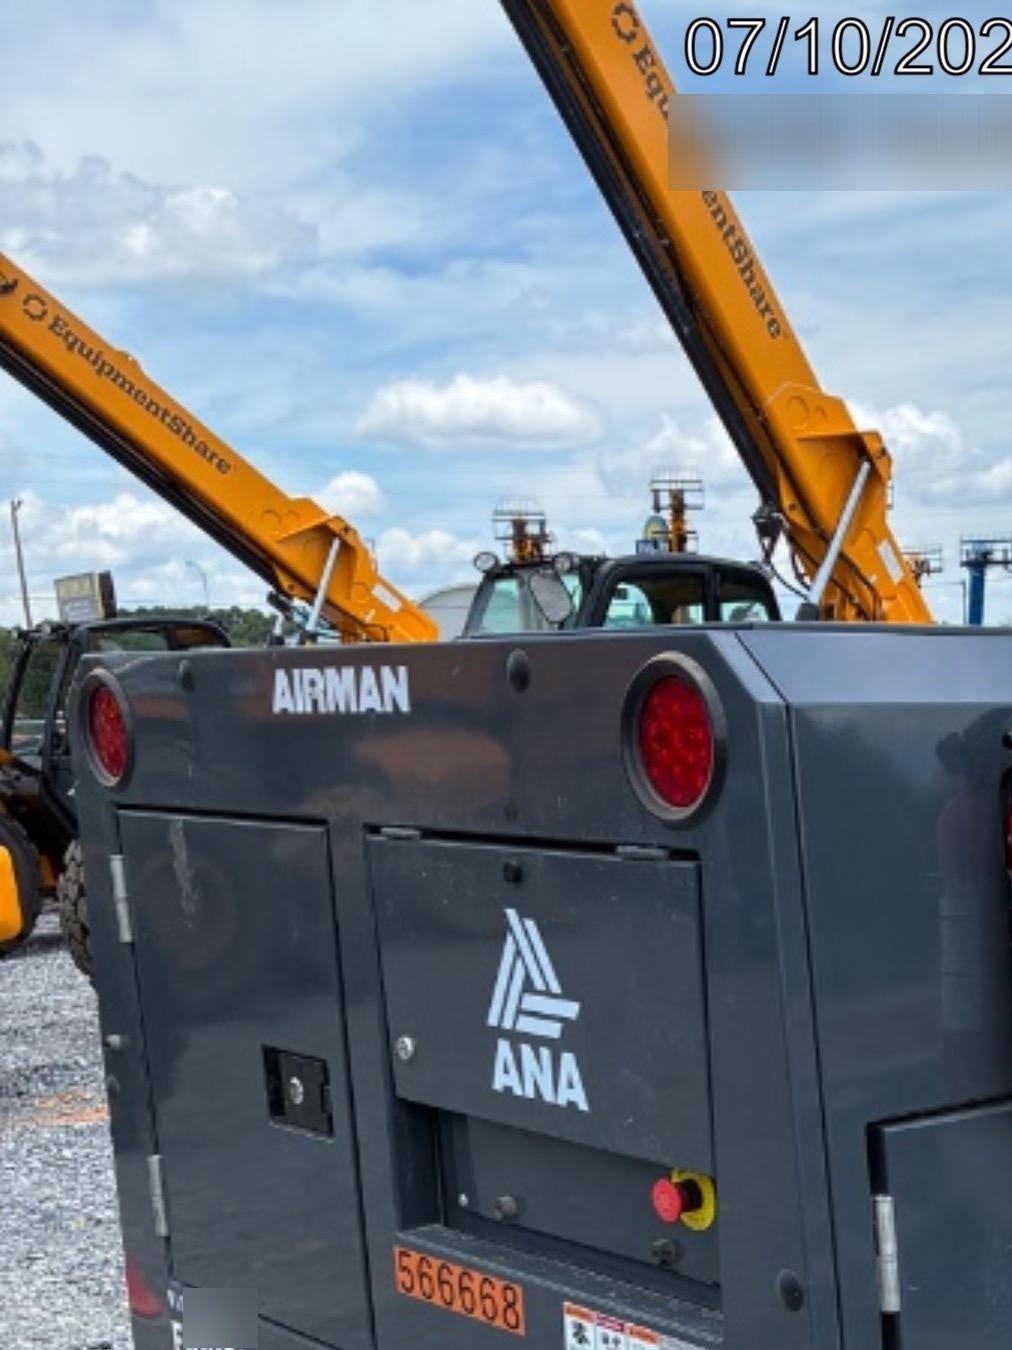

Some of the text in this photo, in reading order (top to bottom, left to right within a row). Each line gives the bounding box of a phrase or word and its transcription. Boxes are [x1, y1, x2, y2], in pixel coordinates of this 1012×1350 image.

[48, 314, 232, 475] EquipmentShare
[272, 664, 412, 715] AIRMAN
[492, 1037, 590, 1112] ANA
[398, 1249, 520, 1330] 566668
